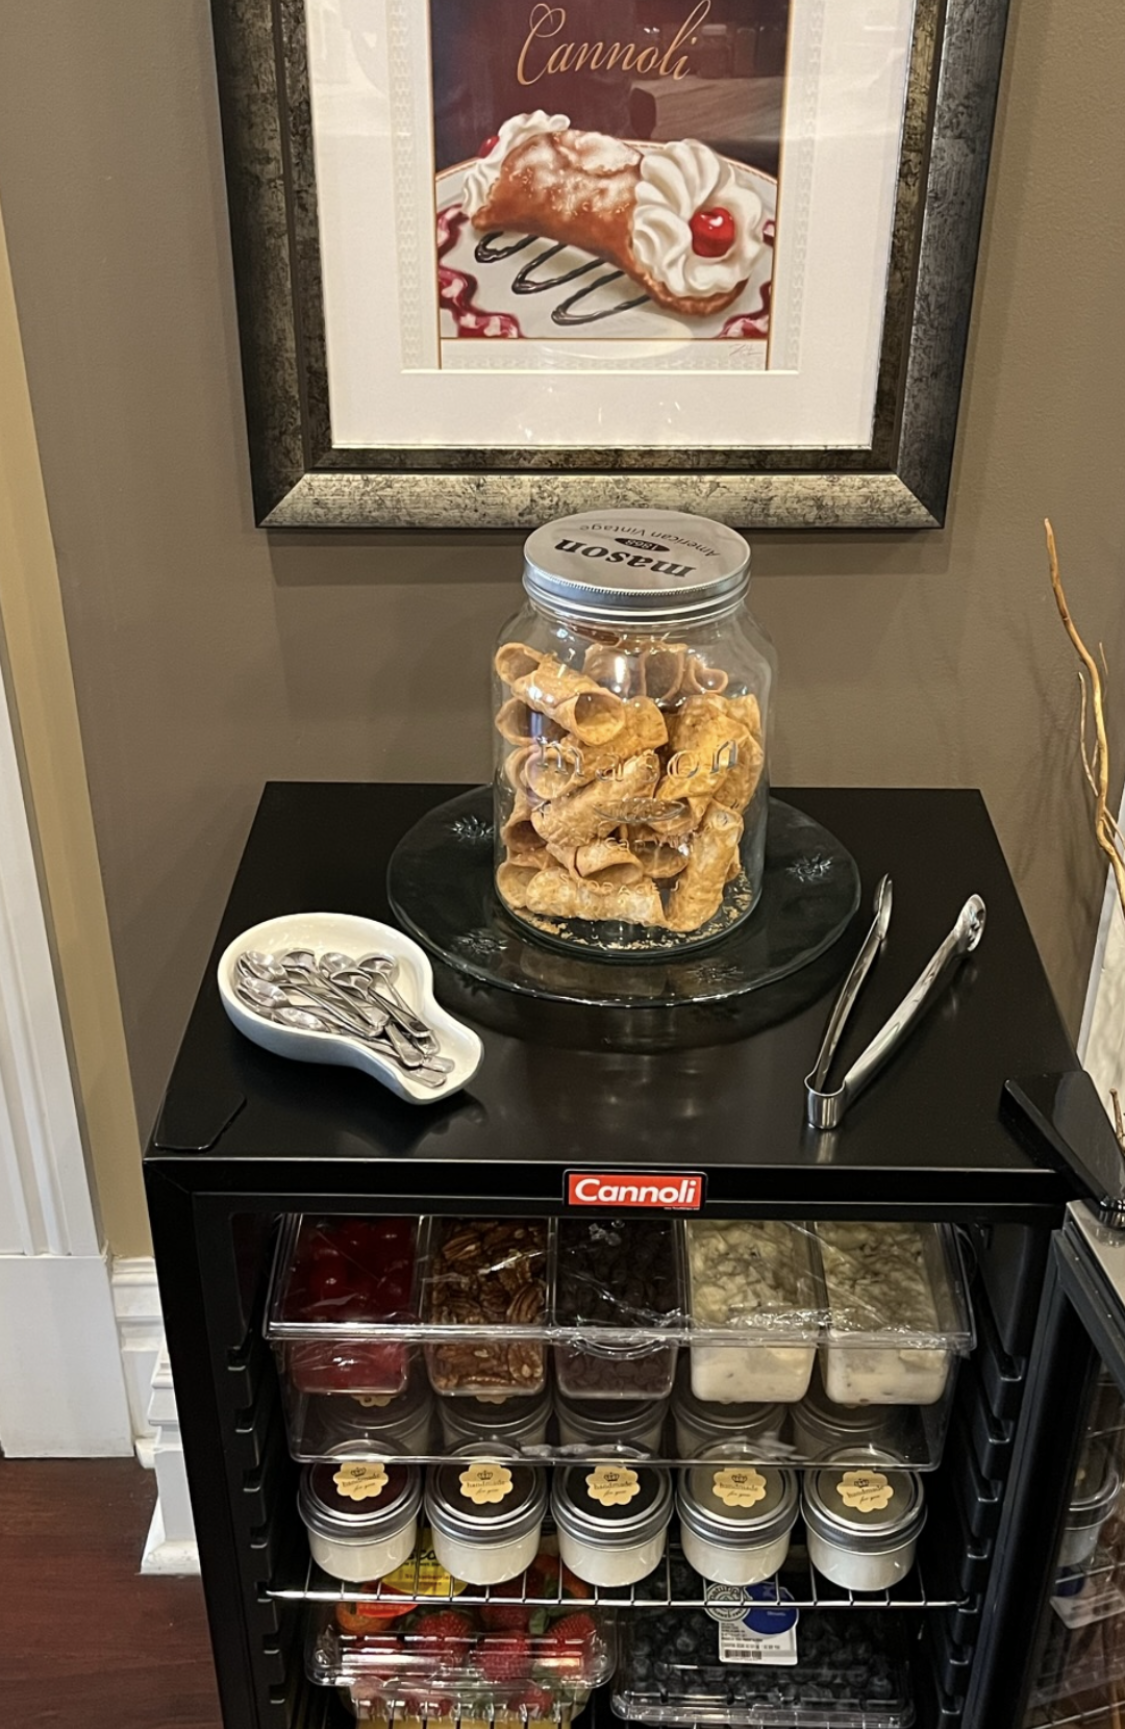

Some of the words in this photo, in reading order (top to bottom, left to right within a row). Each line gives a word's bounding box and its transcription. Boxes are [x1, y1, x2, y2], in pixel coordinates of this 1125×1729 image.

[517, 0, 711, 85] Cannoli
[579, 523, 646, 538] Vintage
[650, 531, 721, 557] American
[554, 538, 698, 578] mason
[575, 1178, 697, 1204] Cannoli
[342, 1474, 381, 1487] handmade
[467, 1480, 505, 1488] handmade
[719, 1482, 758, 1491] handmade
[847, 1485, 885, 1498] handmade
